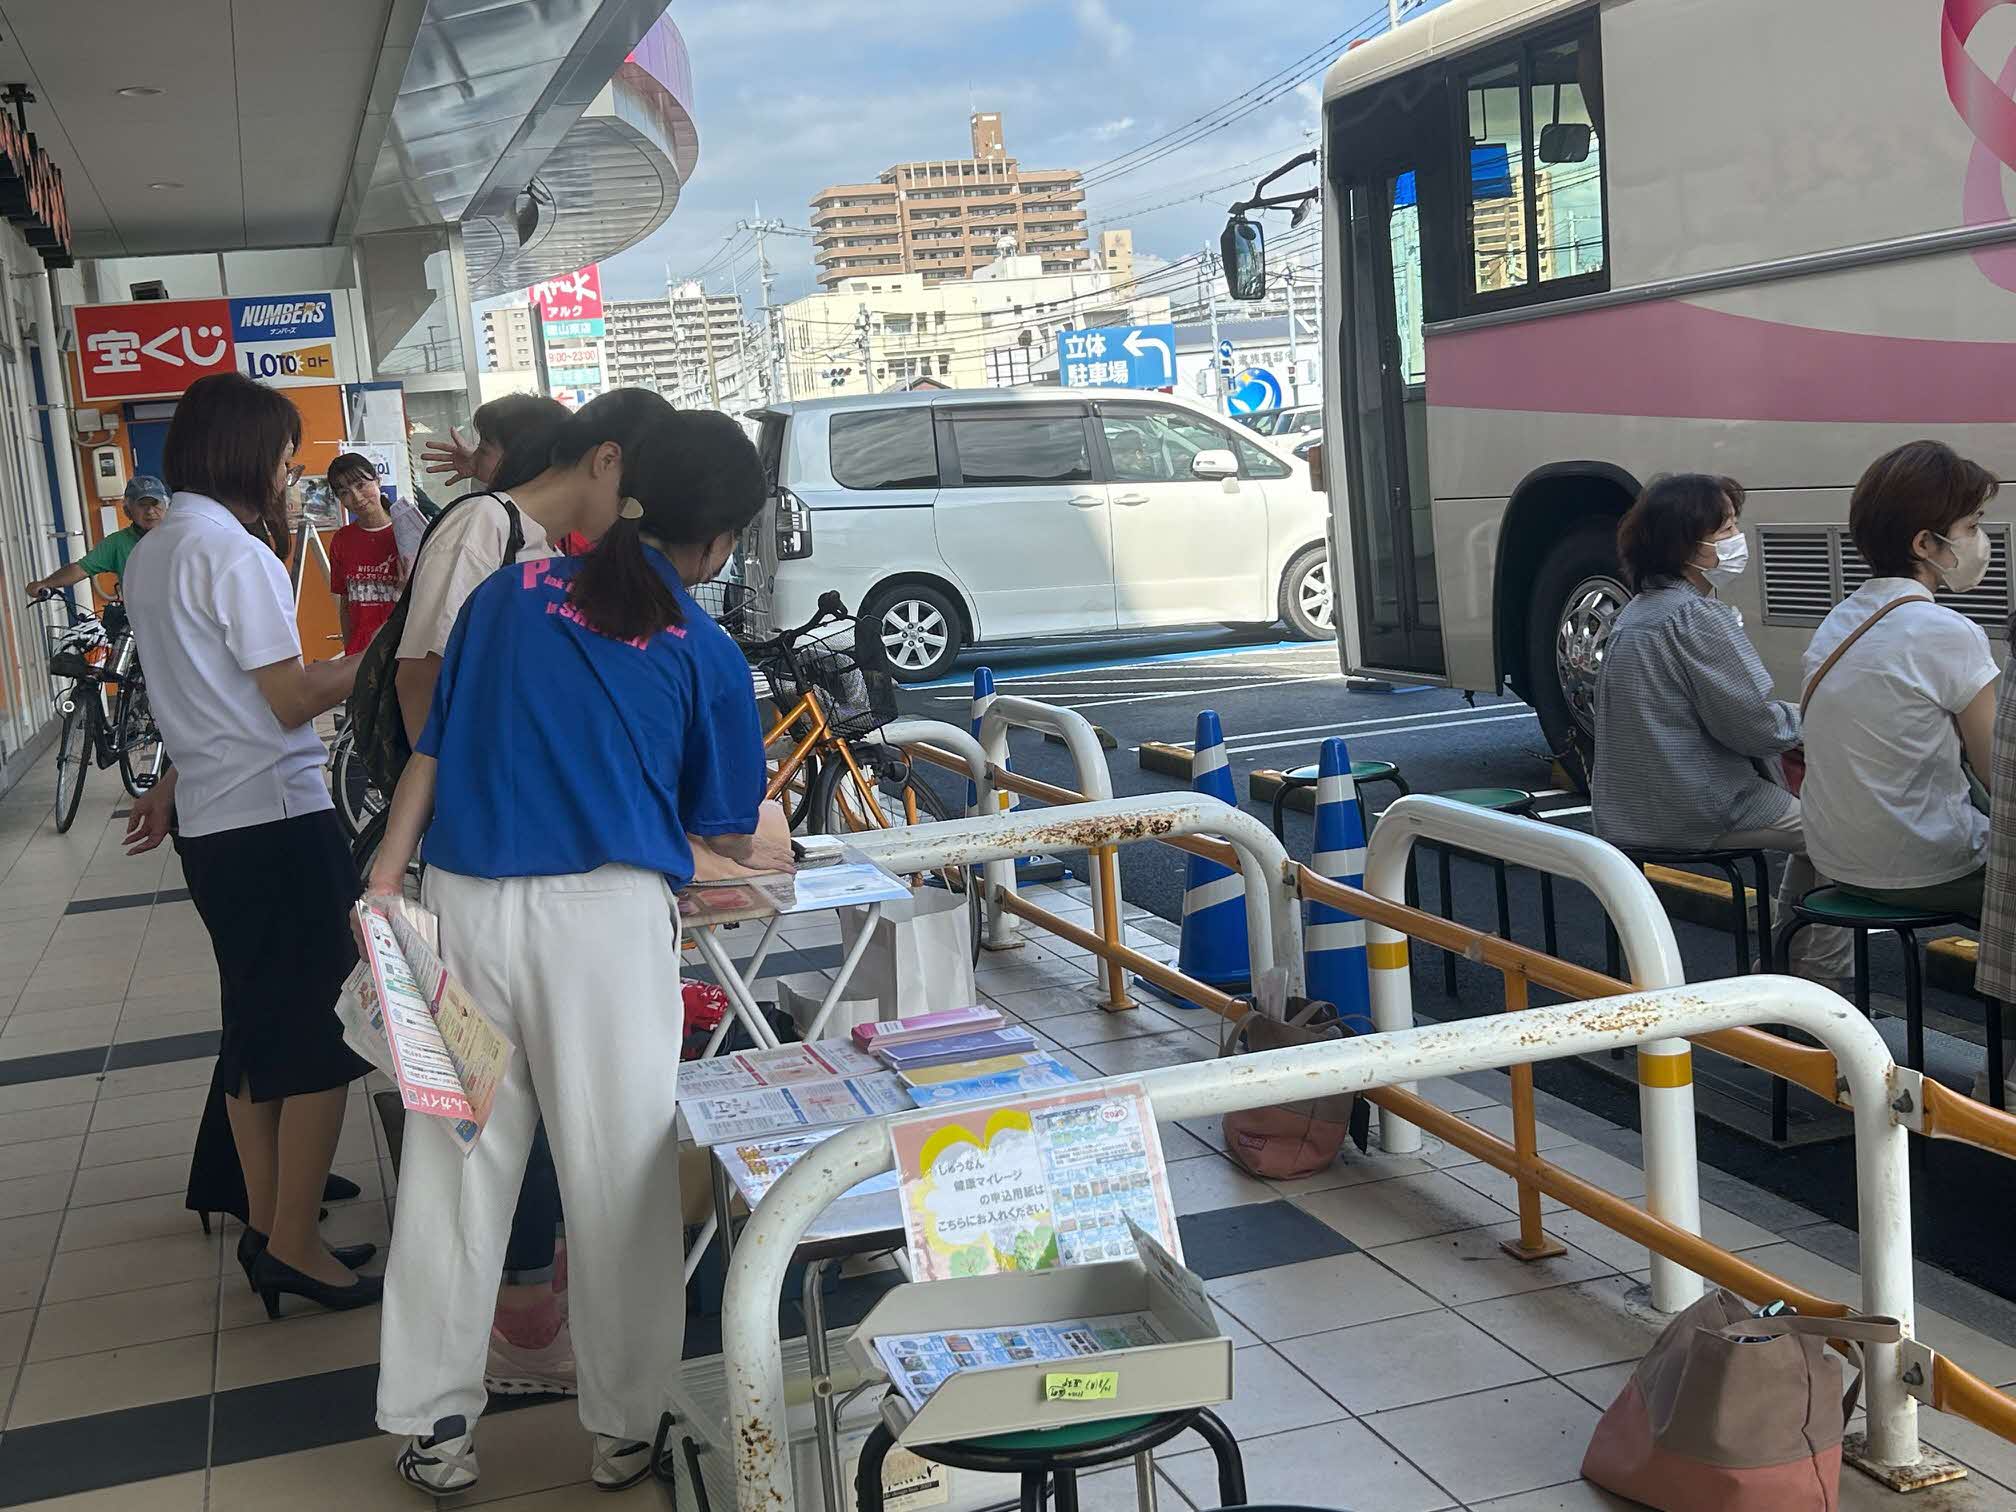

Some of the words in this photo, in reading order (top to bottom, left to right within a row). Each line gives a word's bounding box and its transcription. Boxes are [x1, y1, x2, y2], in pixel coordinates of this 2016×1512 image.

[240, 301, 326, 328] NUMBERS
[547, 305, 583, 318] アルク
[269, 326, 298, 335] ナンバーズ
[87, 325, 227, 374] 宝くじ
[1065, 333, 1107, 359] 立体
[245, 351, 298, 379] LOTO
[1067, 360, 1129, 387] 駐車場
[954, 1168, 1023, 1192] 健康マイレージ
[980, 1183, 1045, 1206] の申込用紙は
